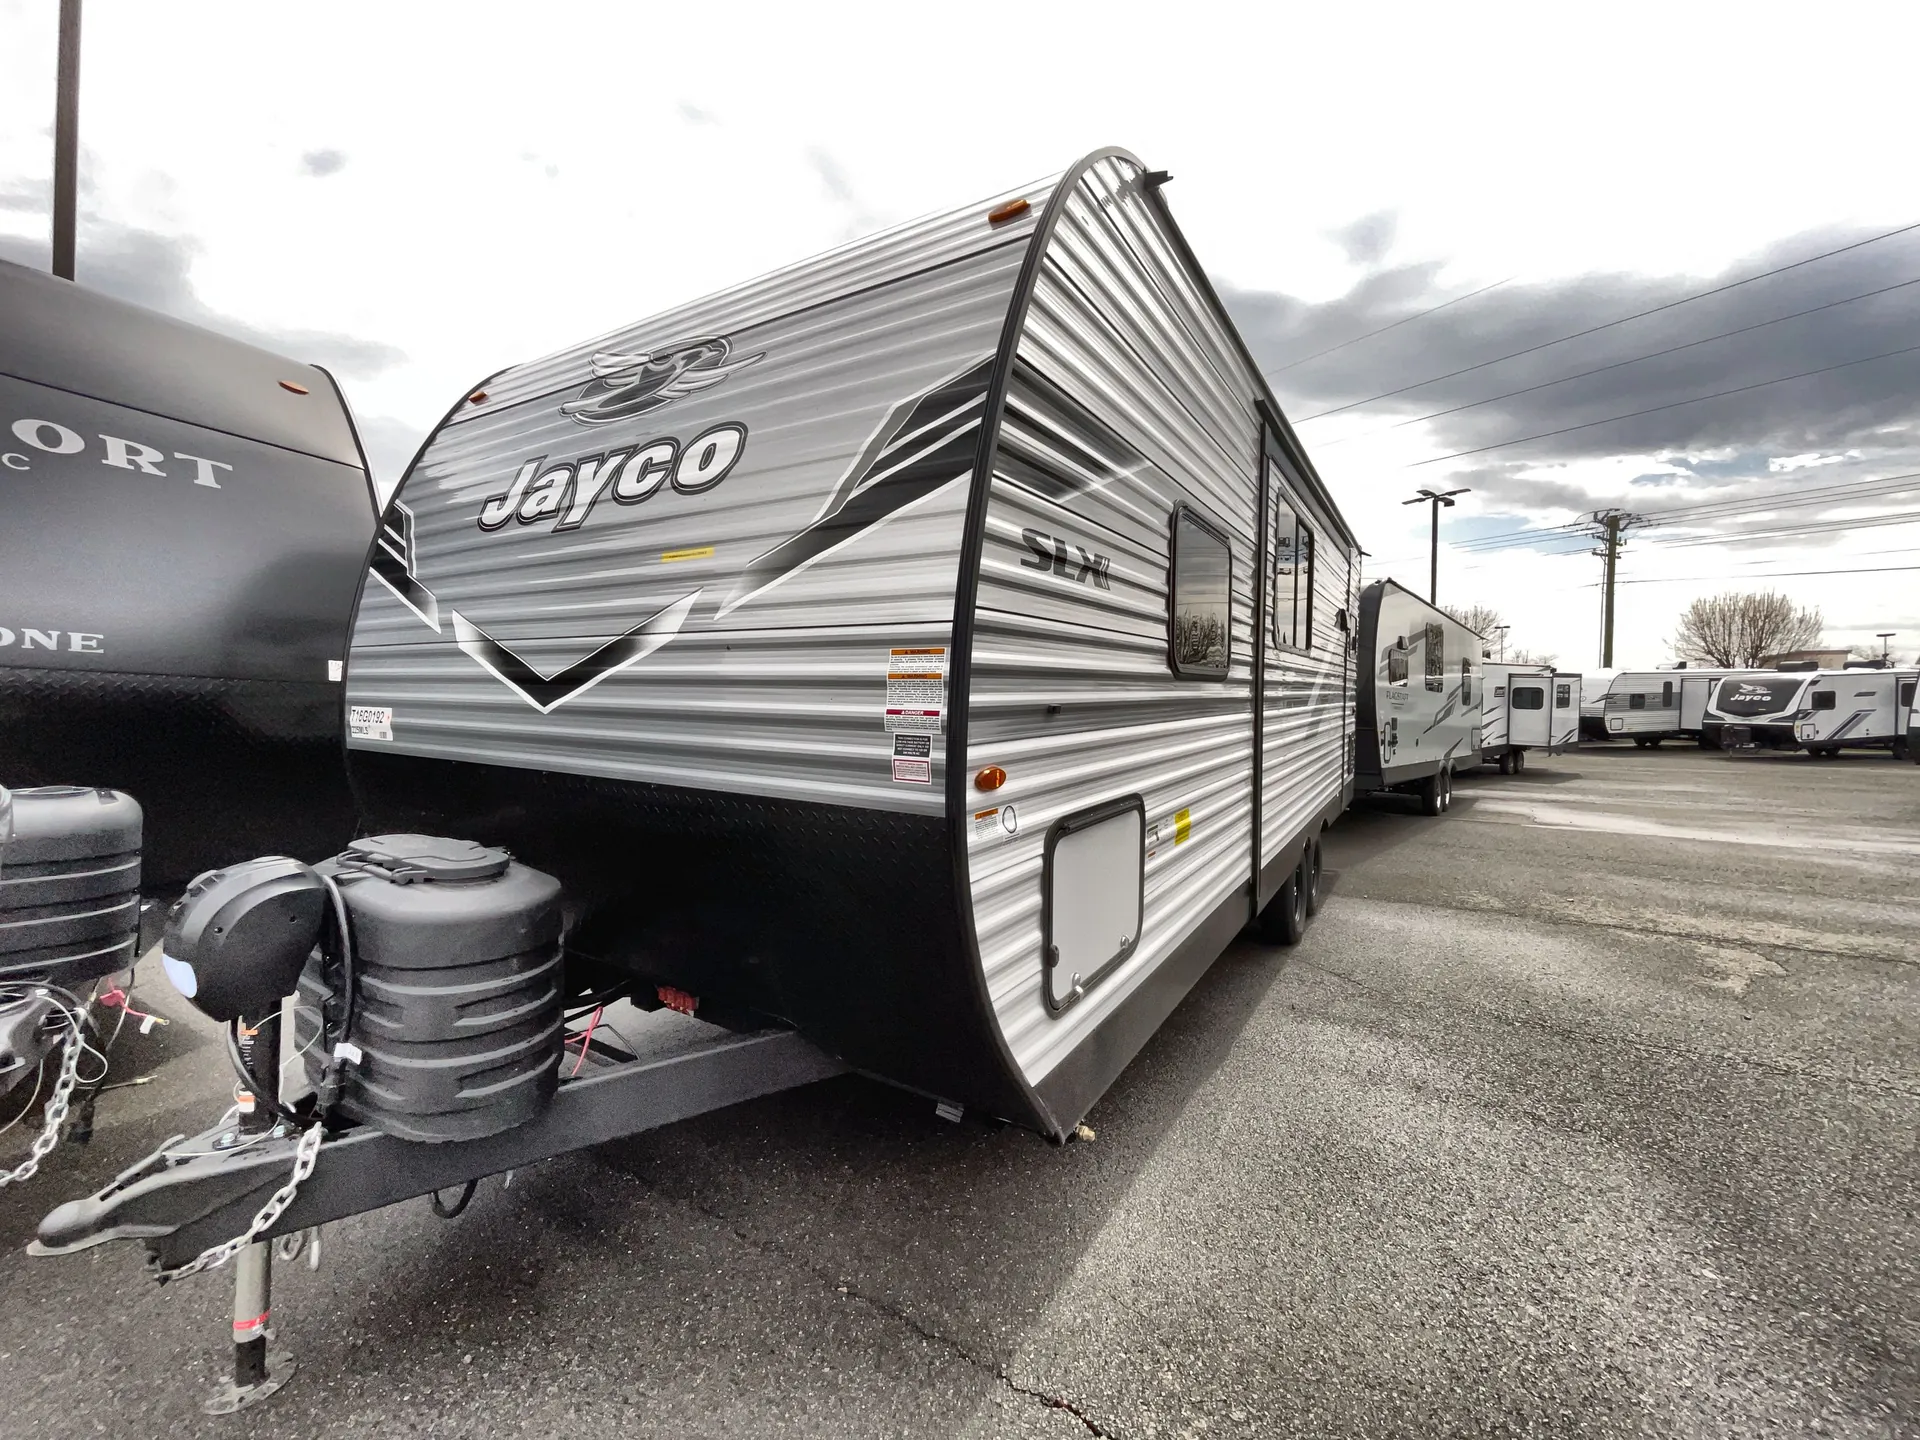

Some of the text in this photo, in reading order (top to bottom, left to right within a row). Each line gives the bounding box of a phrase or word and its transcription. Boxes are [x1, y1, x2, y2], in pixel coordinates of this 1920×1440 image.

[1, 452, 31, 470] C
[11, 418, 233, 489] ORT
[477, 421, 749, 533] Jayco
[1020, 528, 1111, 591] SLX
[1730, 693, 1772, 702] Jayco
